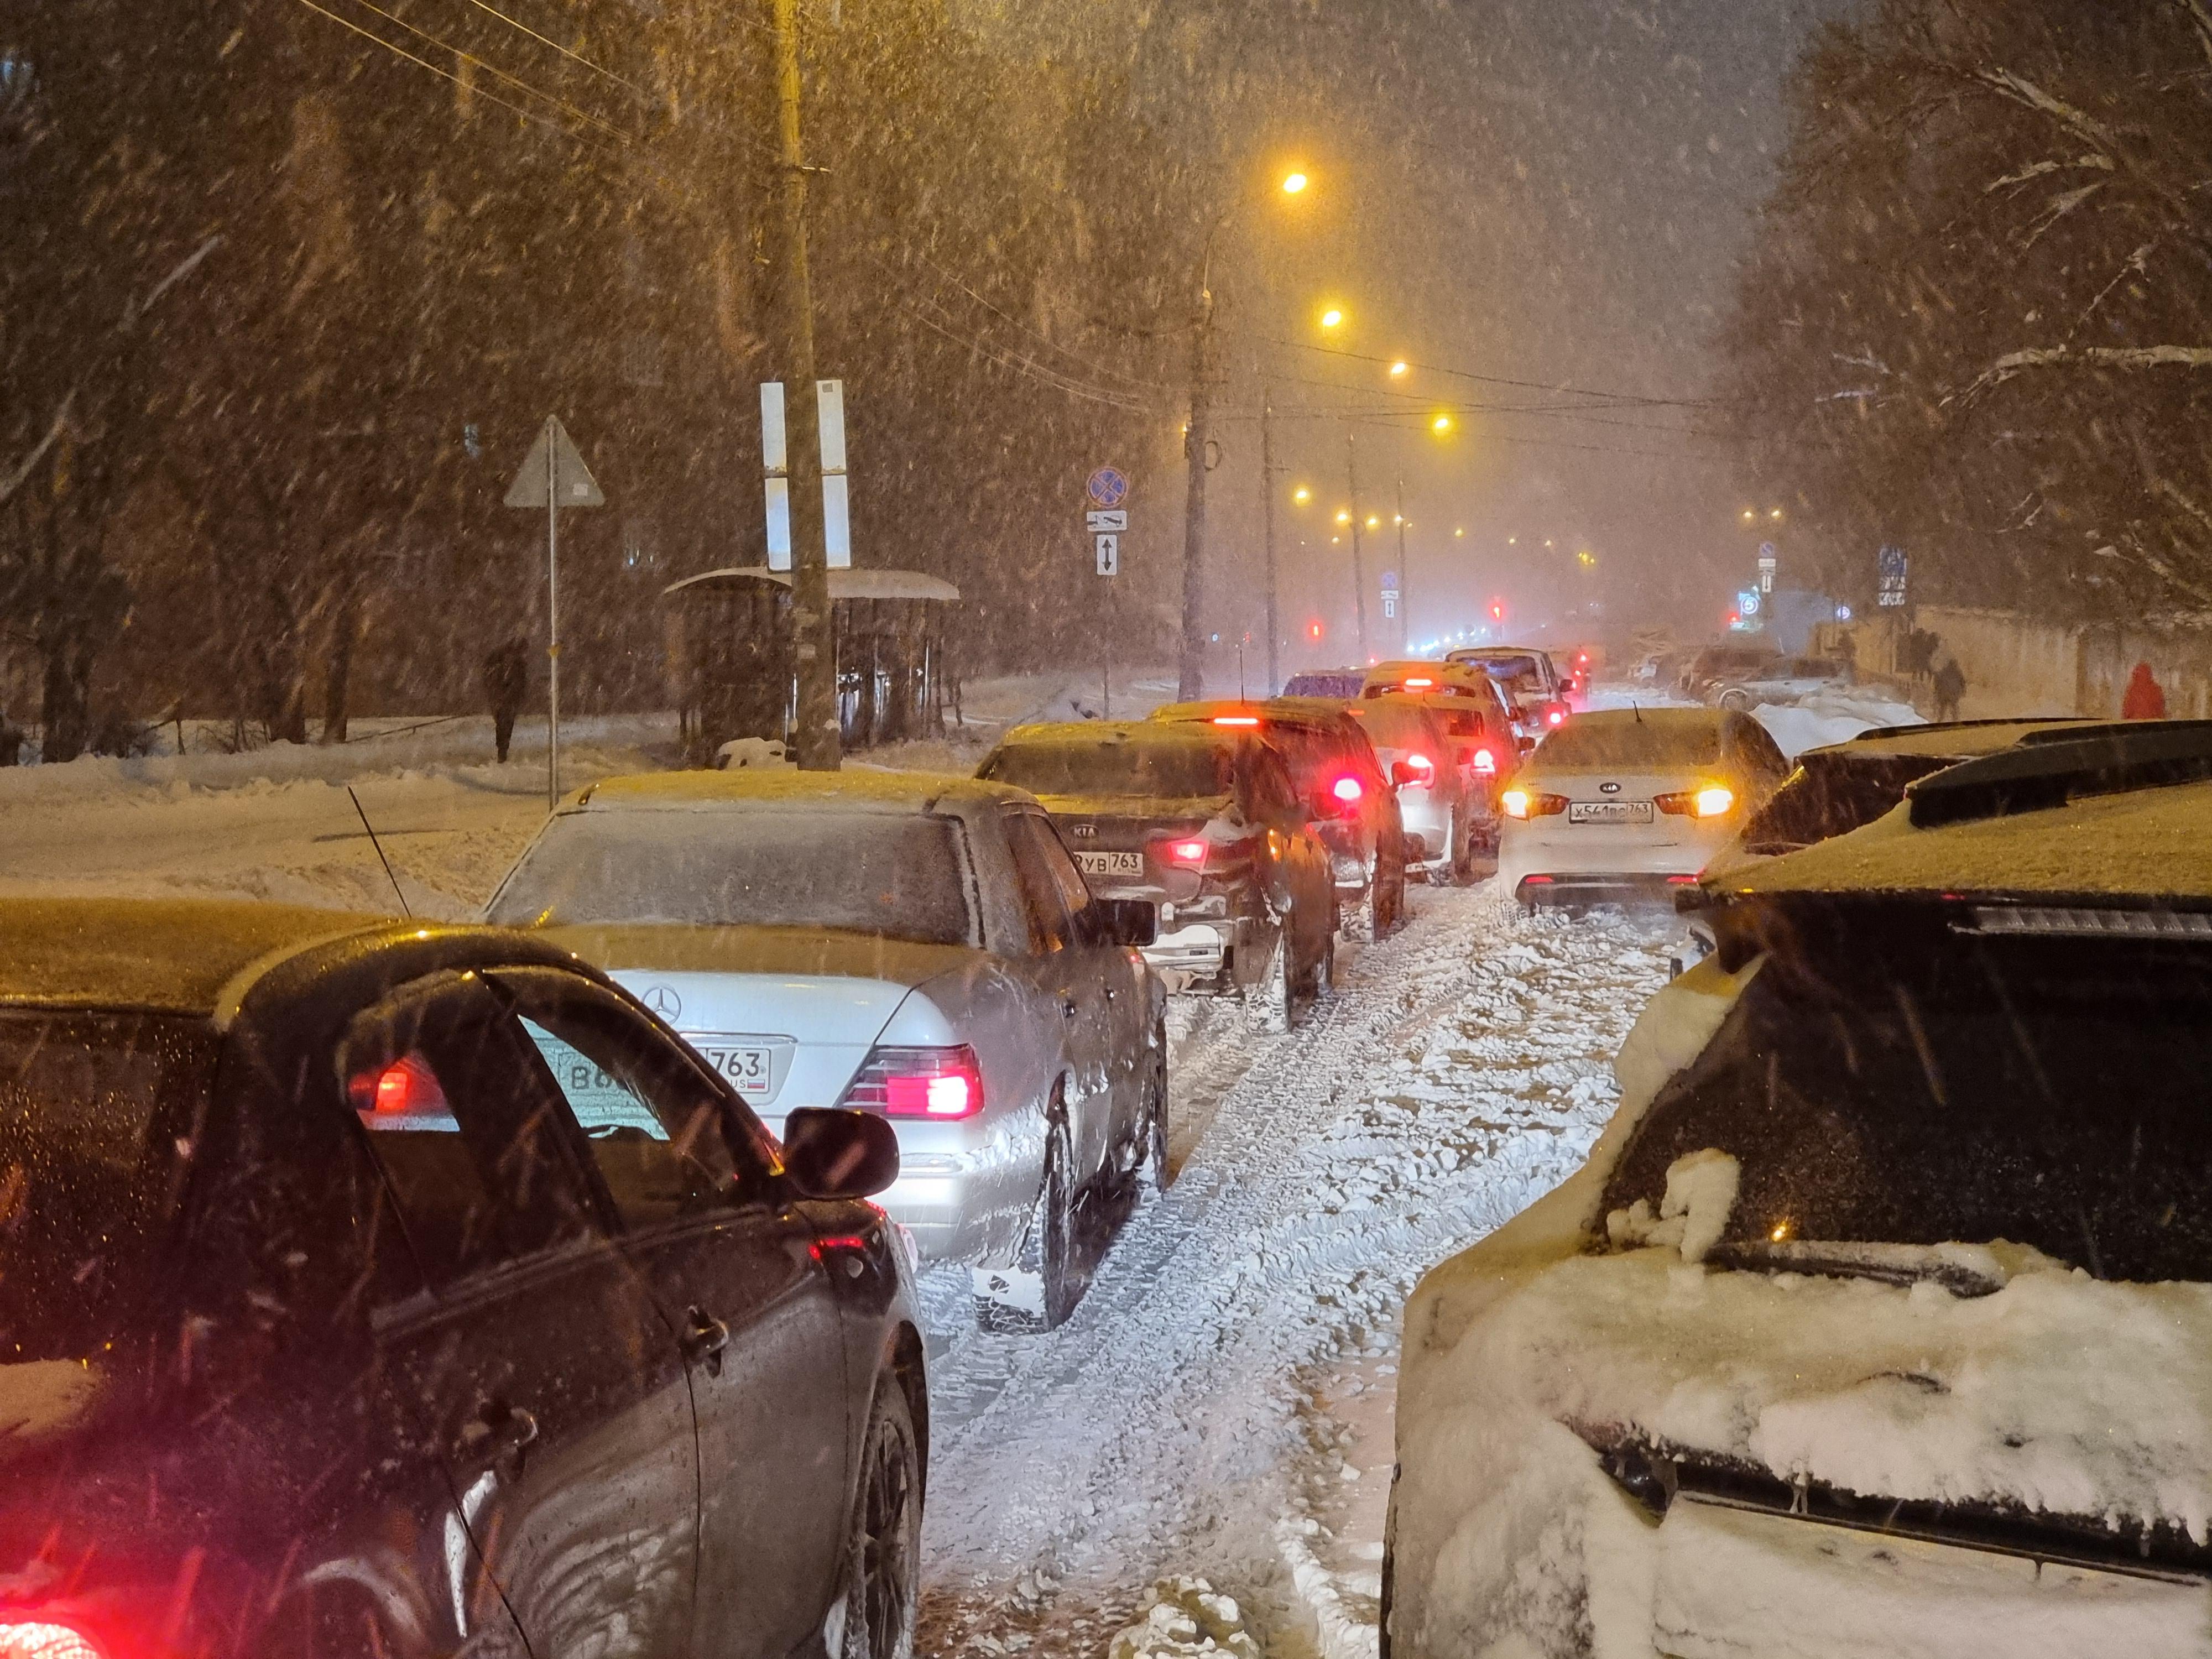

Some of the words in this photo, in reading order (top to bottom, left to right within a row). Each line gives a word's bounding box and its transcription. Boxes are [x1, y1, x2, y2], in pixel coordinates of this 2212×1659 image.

[1074, 827, 1095, 837] KIA
[1112, 854, 1138, 868] 763
[711, 1052, 760, 1077] 763
